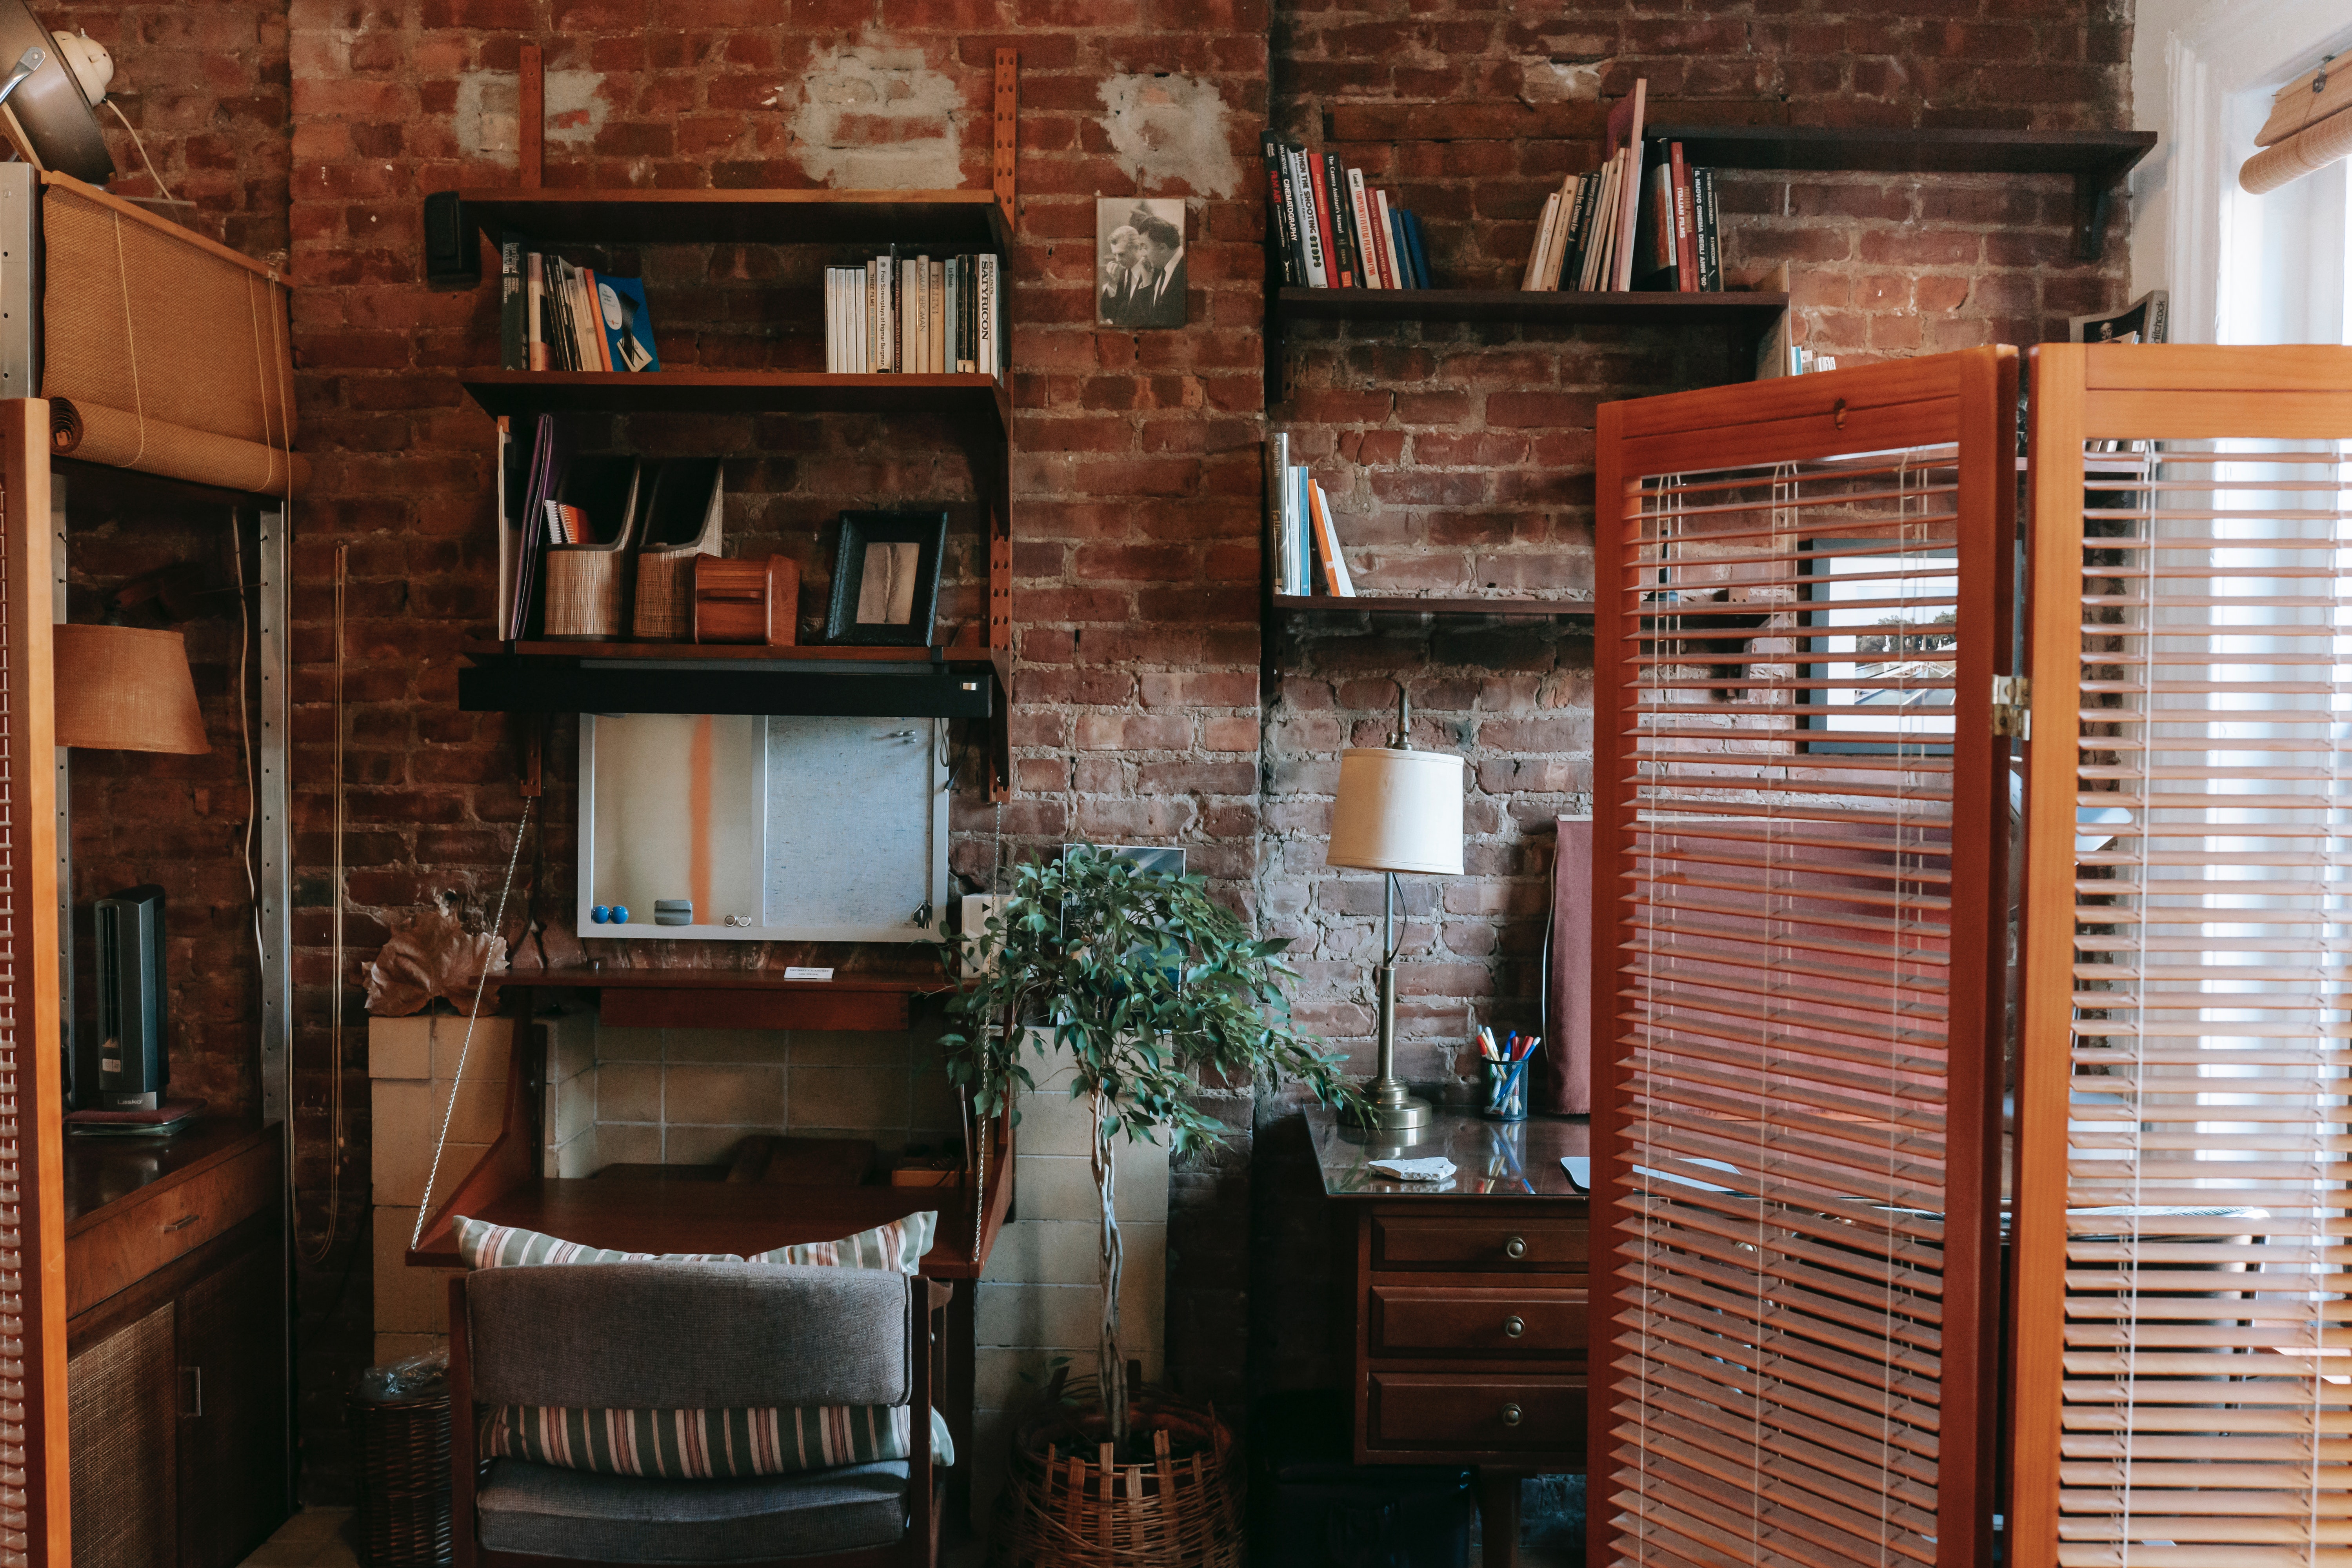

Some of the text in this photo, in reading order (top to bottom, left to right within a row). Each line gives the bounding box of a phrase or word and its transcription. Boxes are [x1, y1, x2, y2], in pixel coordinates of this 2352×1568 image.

[1279, 145, 1288, 174] MALKIEWICZ
[1270, 171, 1281, 204] FILM ART
[1317, 185, 1325, 215] SCHEDULING
[1332, 188, 1341, 213] Assistant's
[1578, 178, 1587, 196] Cinema
[1588, 178, 1598, 196] Discovery
[1283, 178, 1298, 241] CINEMATOGRAPHY
[1297, 152, 1321, 268] WHEN THE SHOOTING STOPS
[1572, 205, 1581, 223] Cinema
[1355, 191, 1366, 219] INDEPENDENT
[1365, 251, 1376, 276] PRODUCTION
[1368, 189, 1377, 218] AMERICAN
[1373, 219, 1386, 272] CINEMATOGRAPHER
[504, 261, 512, 273] Allen
